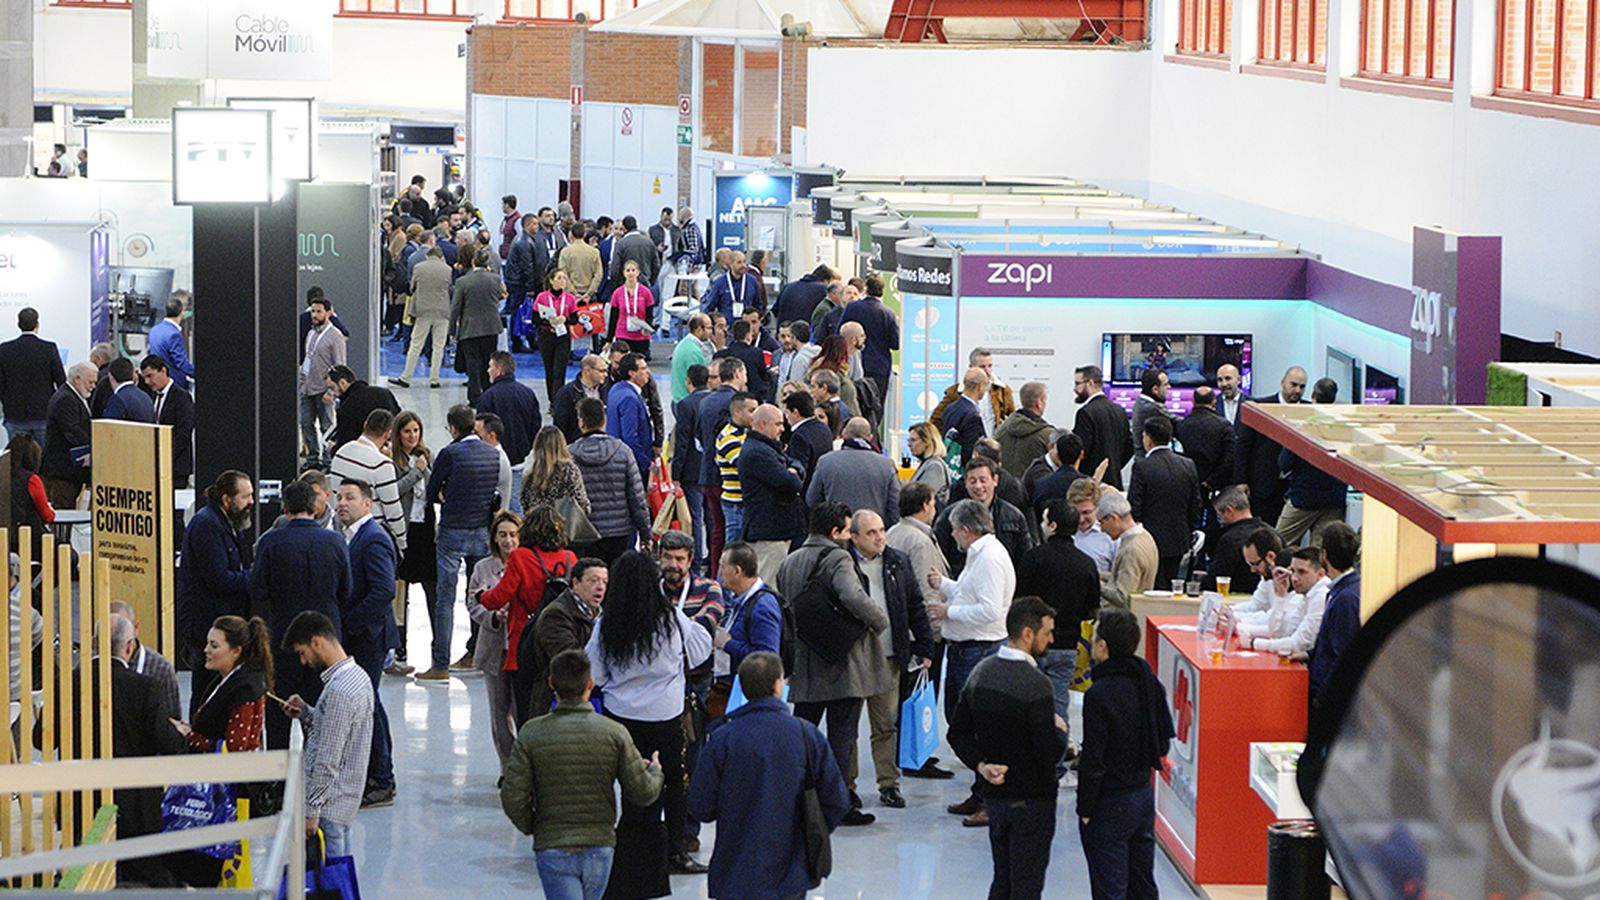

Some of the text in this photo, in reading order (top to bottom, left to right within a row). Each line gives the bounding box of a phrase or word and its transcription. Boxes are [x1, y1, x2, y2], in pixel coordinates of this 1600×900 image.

[235, 14, 290, 34] Cable
[235, 35, 287, 53] Móvil
[917, 267, 952, 286] Redes
[986, 262, 1053, 292] zapi
[96, 484, 153, 513] SIEMPRE
[96, 508, 153, 538] CONTIGO
